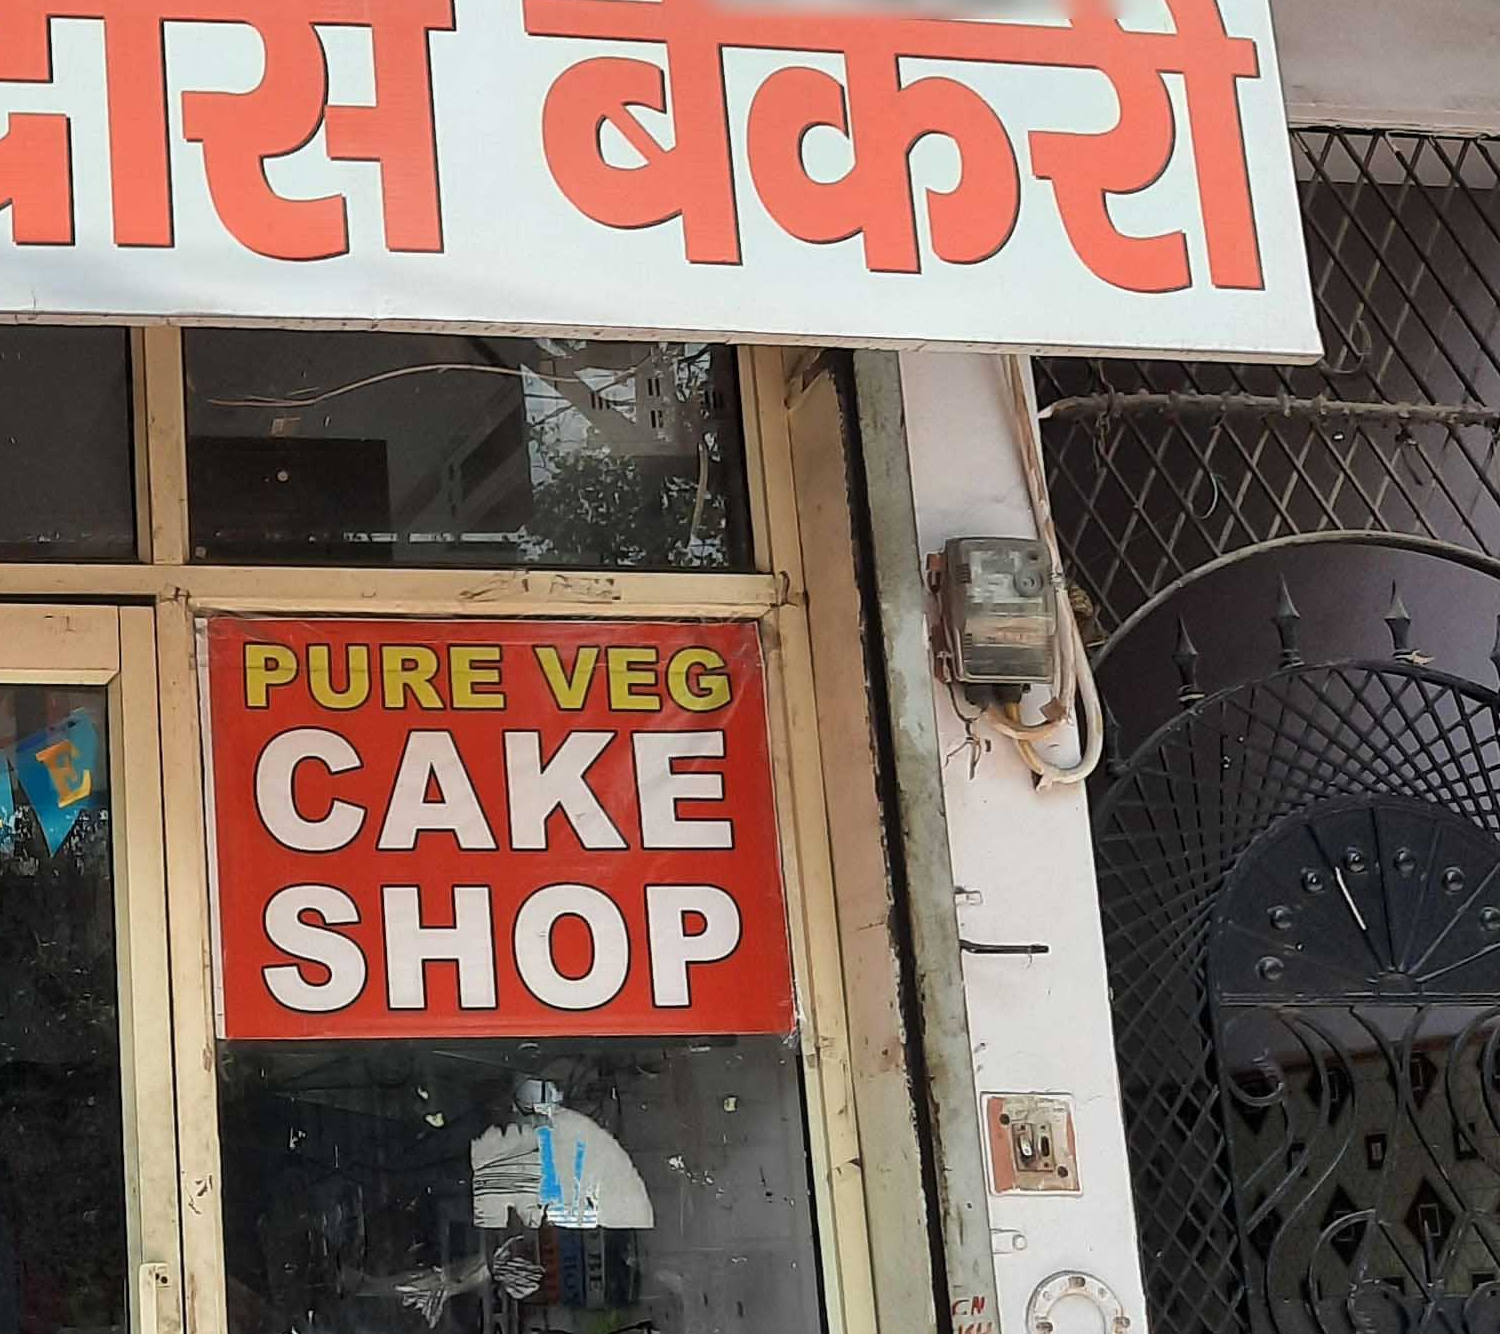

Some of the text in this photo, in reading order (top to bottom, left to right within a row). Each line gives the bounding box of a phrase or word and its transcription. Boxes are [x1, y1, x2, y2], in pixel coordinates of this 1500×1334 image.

[243, 643, 734, 712] PURE VEG
[253, 728, 736, 854] CAKE
[260, 881, 743, 1012] SHOP
